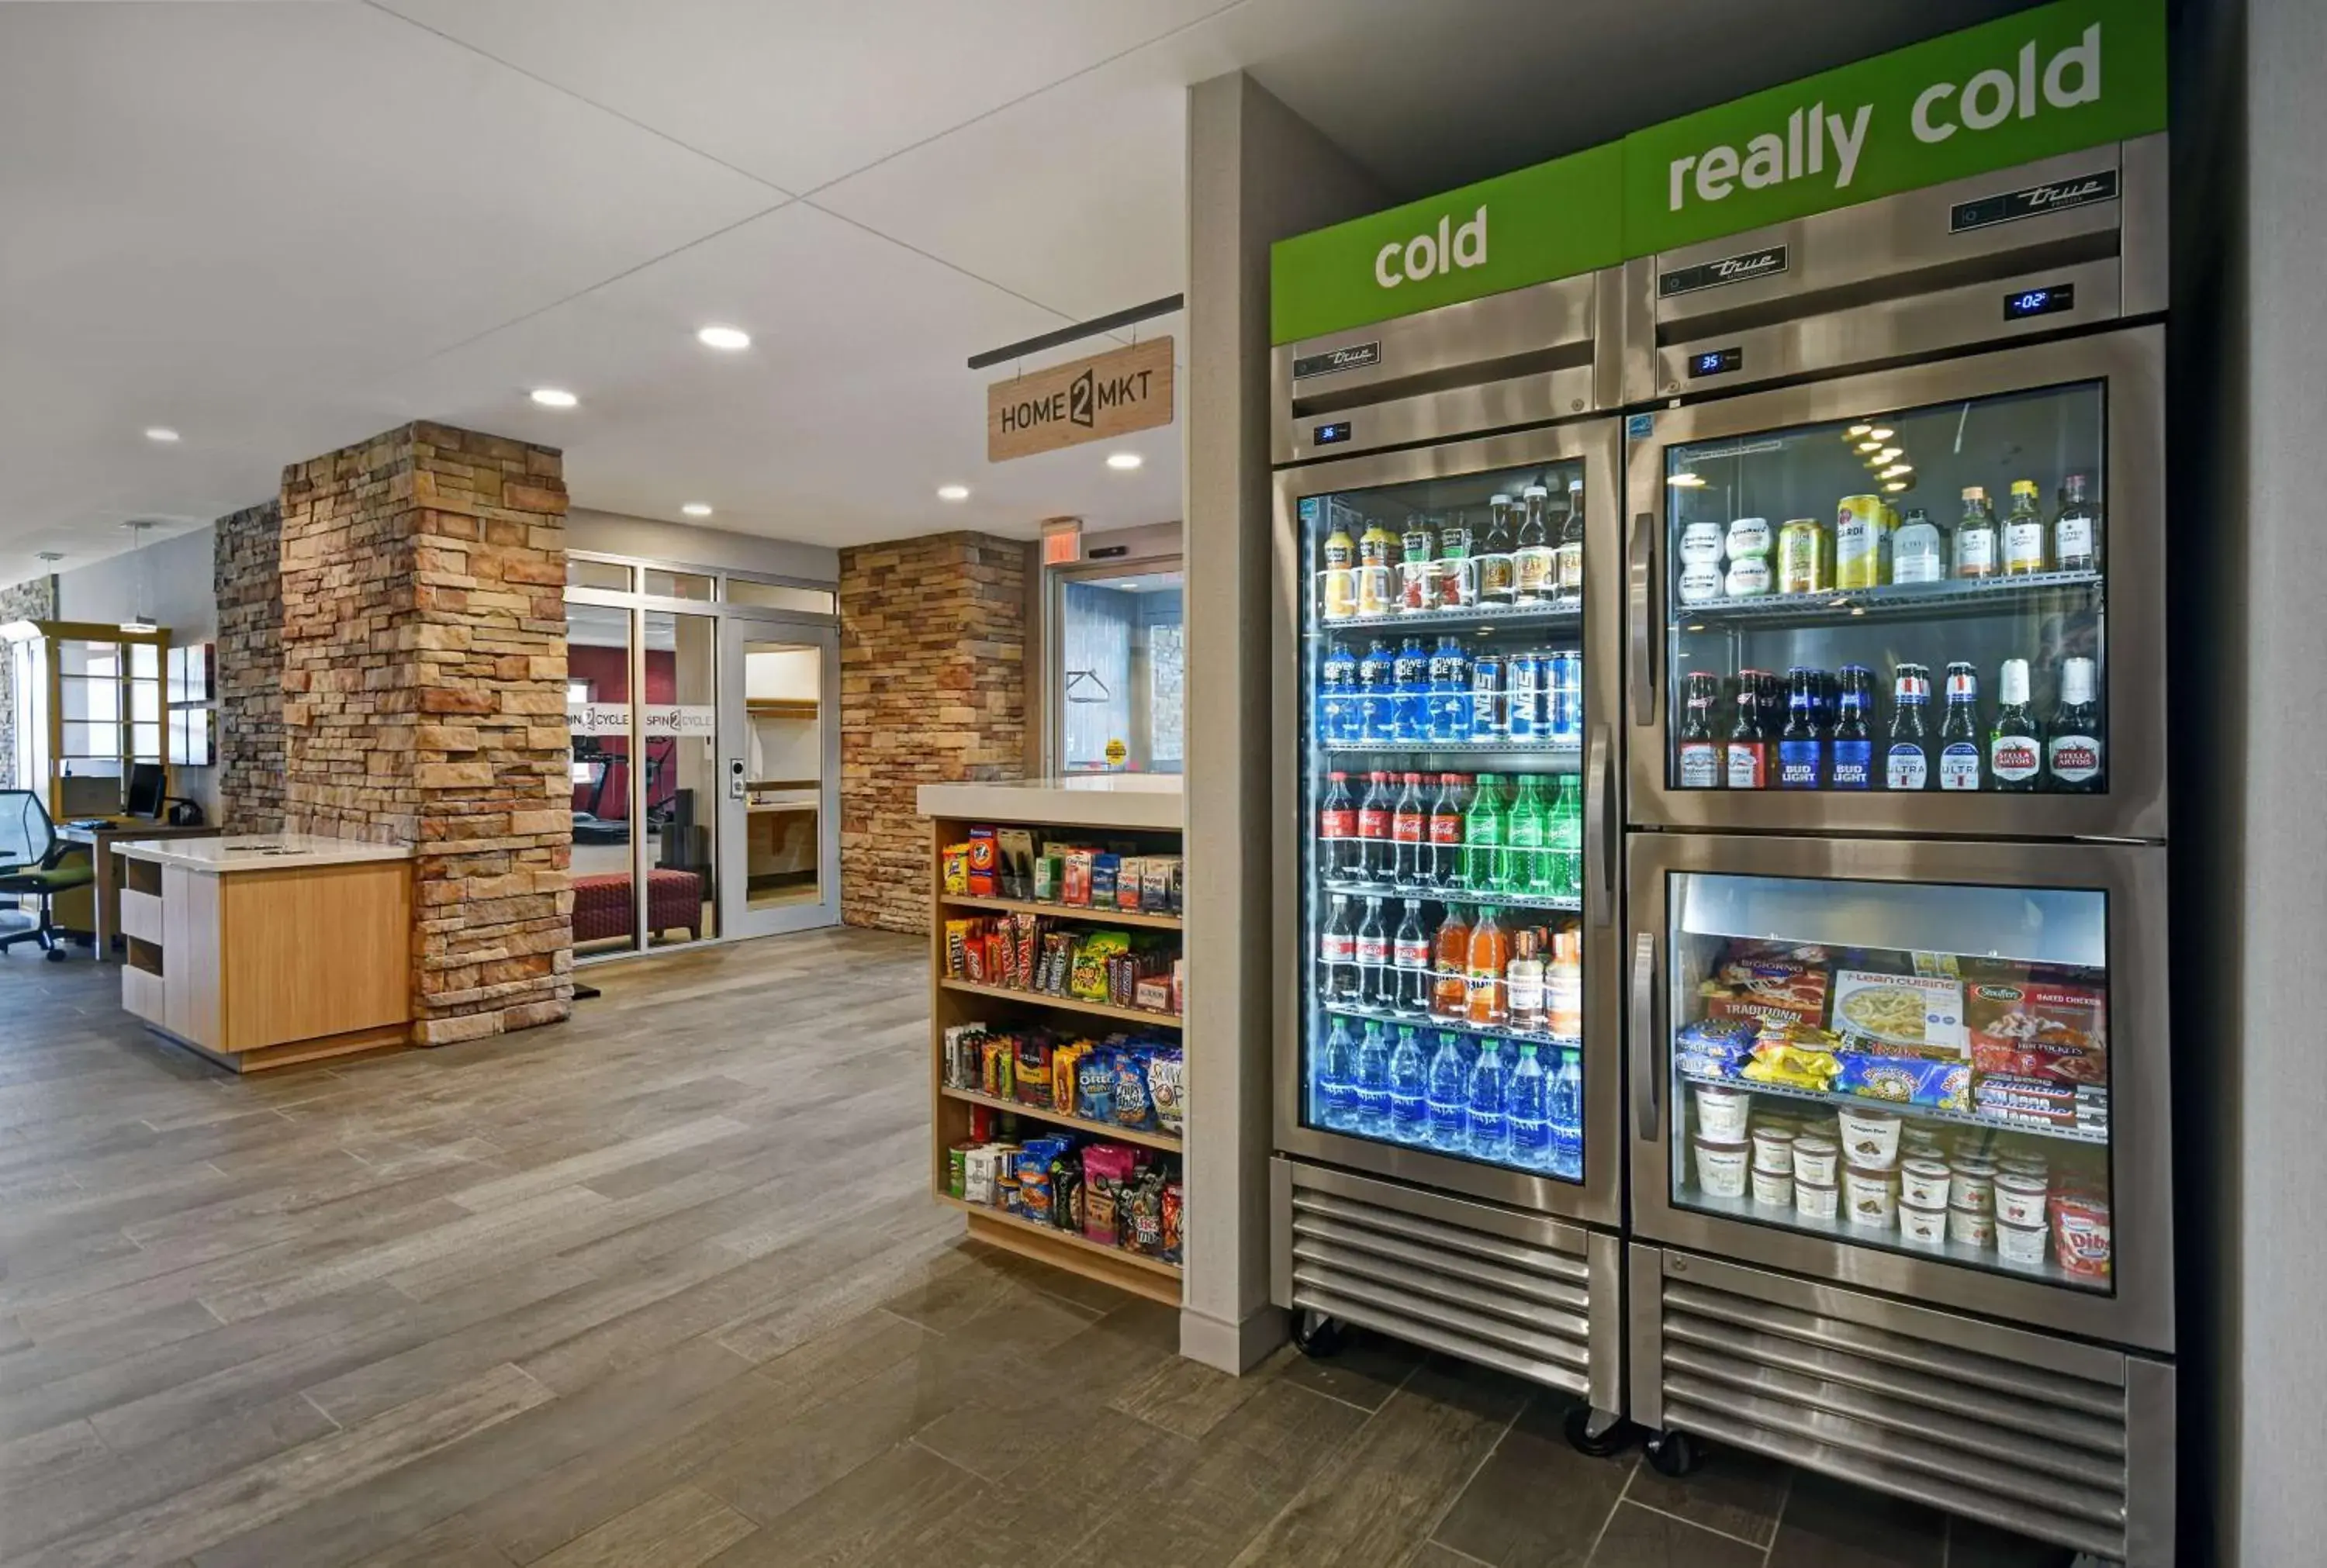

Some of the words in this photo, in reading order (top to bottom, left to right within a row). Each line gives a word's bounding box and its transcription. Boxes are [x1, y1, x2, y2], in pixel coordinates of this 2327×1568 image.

[1668, 101, 1874, 211] really
[1910, 21, 2101, 145] cold
[1375, 205, 1487, 288] cold
[1782, 773, 1816, 782] LIGHT
[1833, 773, 1866, 782] LIGHT
